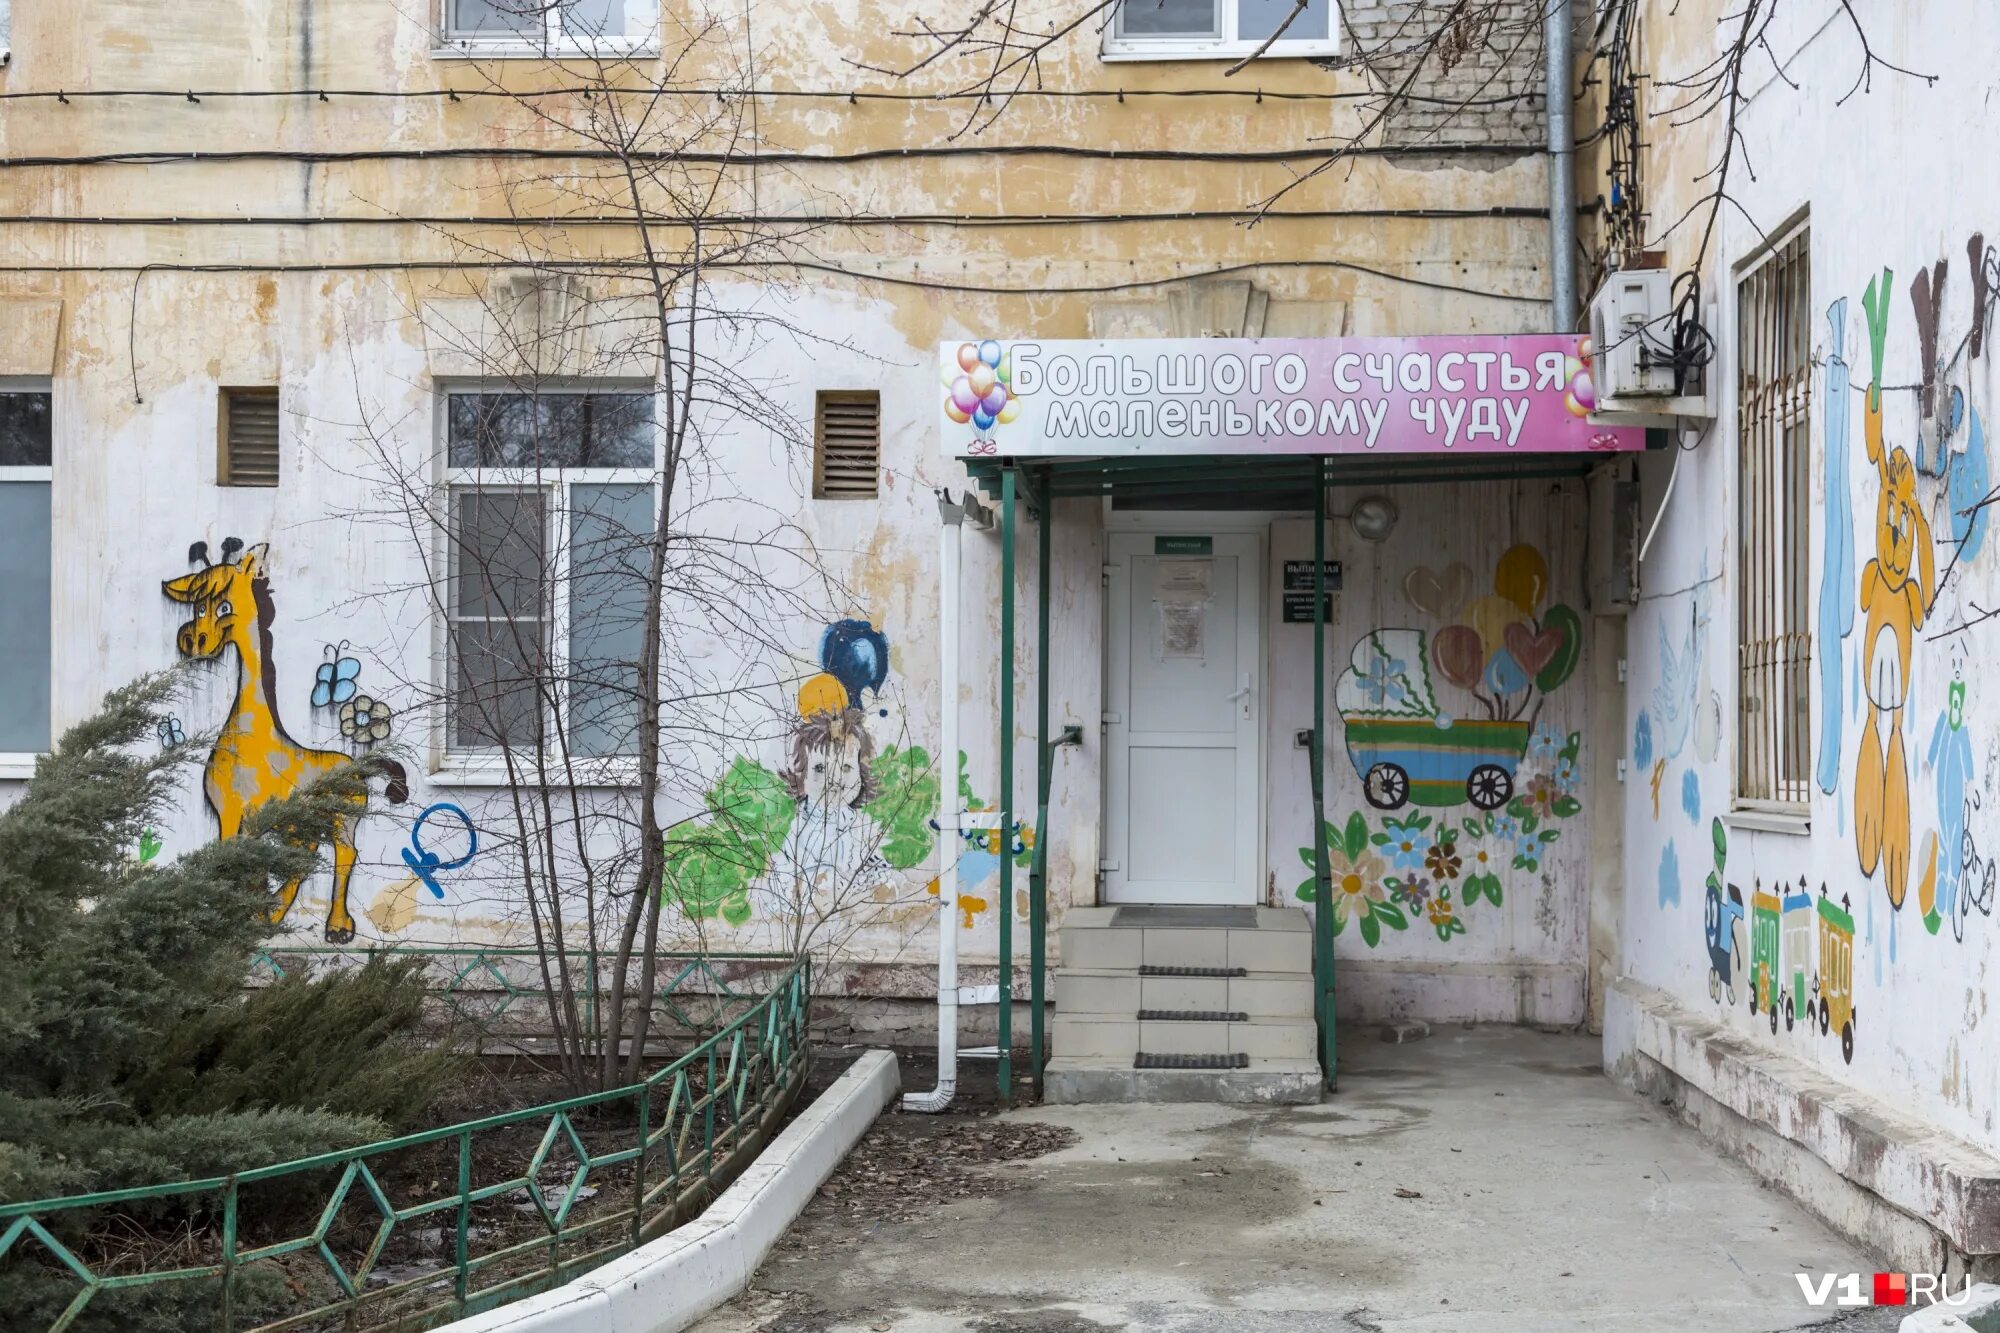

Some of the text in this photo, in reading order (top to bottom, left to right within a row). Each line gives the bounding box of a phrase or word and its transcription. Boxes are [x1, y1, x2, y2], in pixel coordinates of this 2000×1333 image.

[1010, 344, 1566, 396] Большого счастья
[1045, 397, 1531, 448] маленькому чуду
[1287, 564, 1339, 573] ВЫПИАЯ
